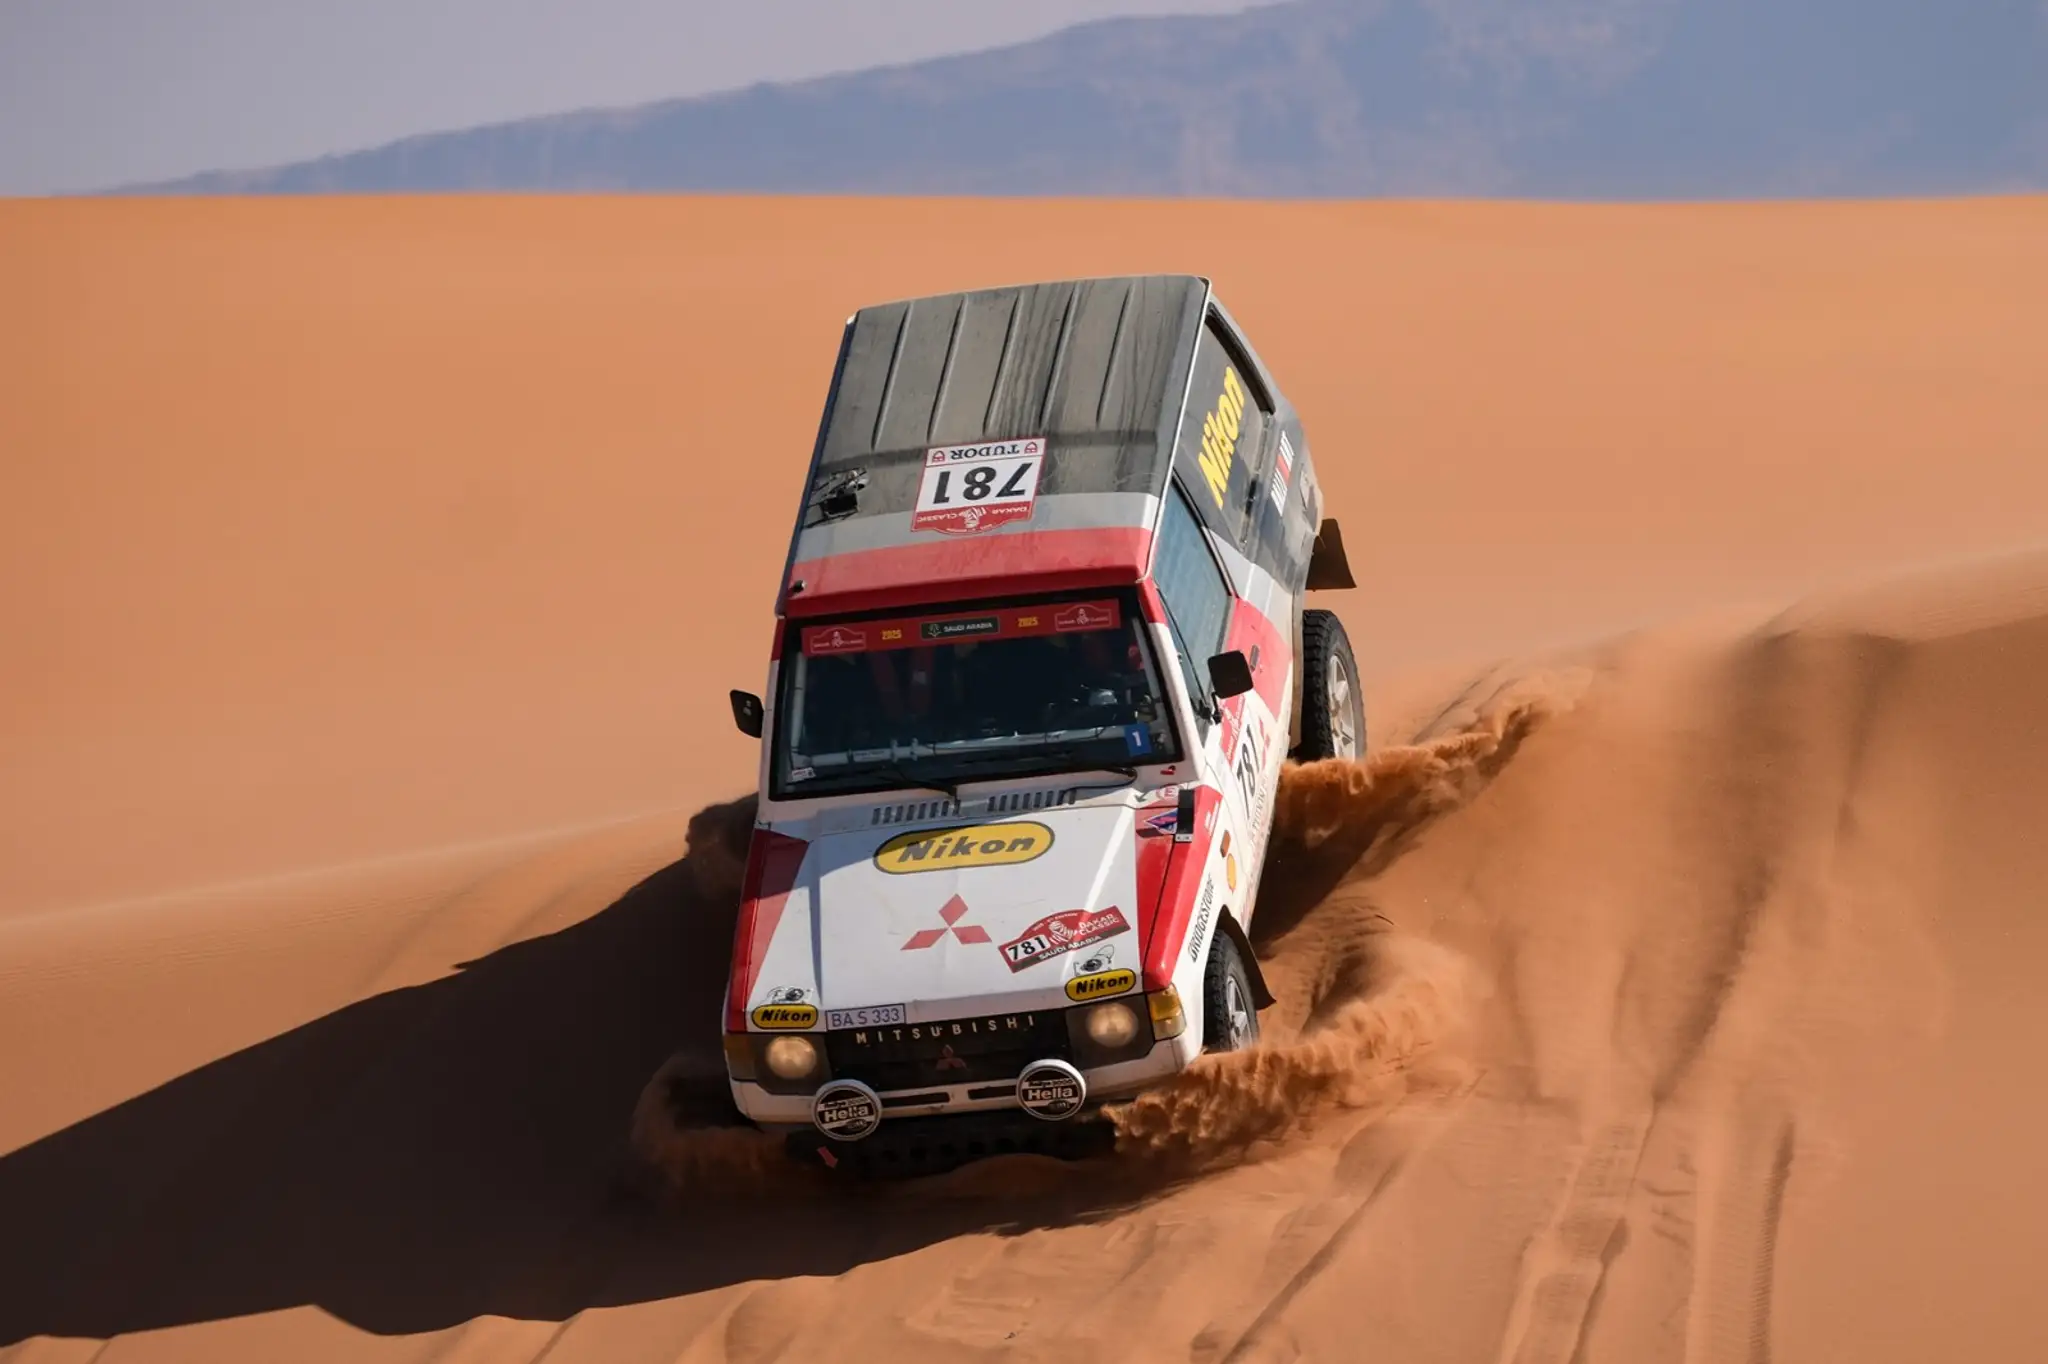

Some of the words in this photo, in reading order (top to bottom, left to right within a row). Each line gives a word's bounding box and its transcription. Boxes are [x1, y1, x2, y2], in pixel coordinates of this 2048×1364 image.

[1198, 366, 1245, 511] Nikon
[950, 443, 1020, 460] TUDOR
[932, 462, 1033, 504] 781
[1017, 616, 1039, 628] 2025
[1131, 730, 1142, 747] 1
[1236, 723, 1260, 819] 781
[897, 836, 1036, 864] Nikon
[1078, 913, 1115, 930] DAKAR
[1079, 918, 1119, 937] CLASSIC
[1007, 935, 1047, 961] 781
[1038, 945, 1067, 961] SAUDI
[1067, 935, 1103, 951] ARABIA
[1075, 975, 1130, 995] Nikon
[760, 1009, 812, 1023] Nikon
[831, 1011, 855, 1028] BA
[857, 1010, 869, 1025] S
[872, 1007, 901, 1023] 333
[855, 1014, 1035, 1045] MITSUBISHI
[1027, 1086, 1074, 1101] Hella
[823, 1105, 870, 1123] Hella
